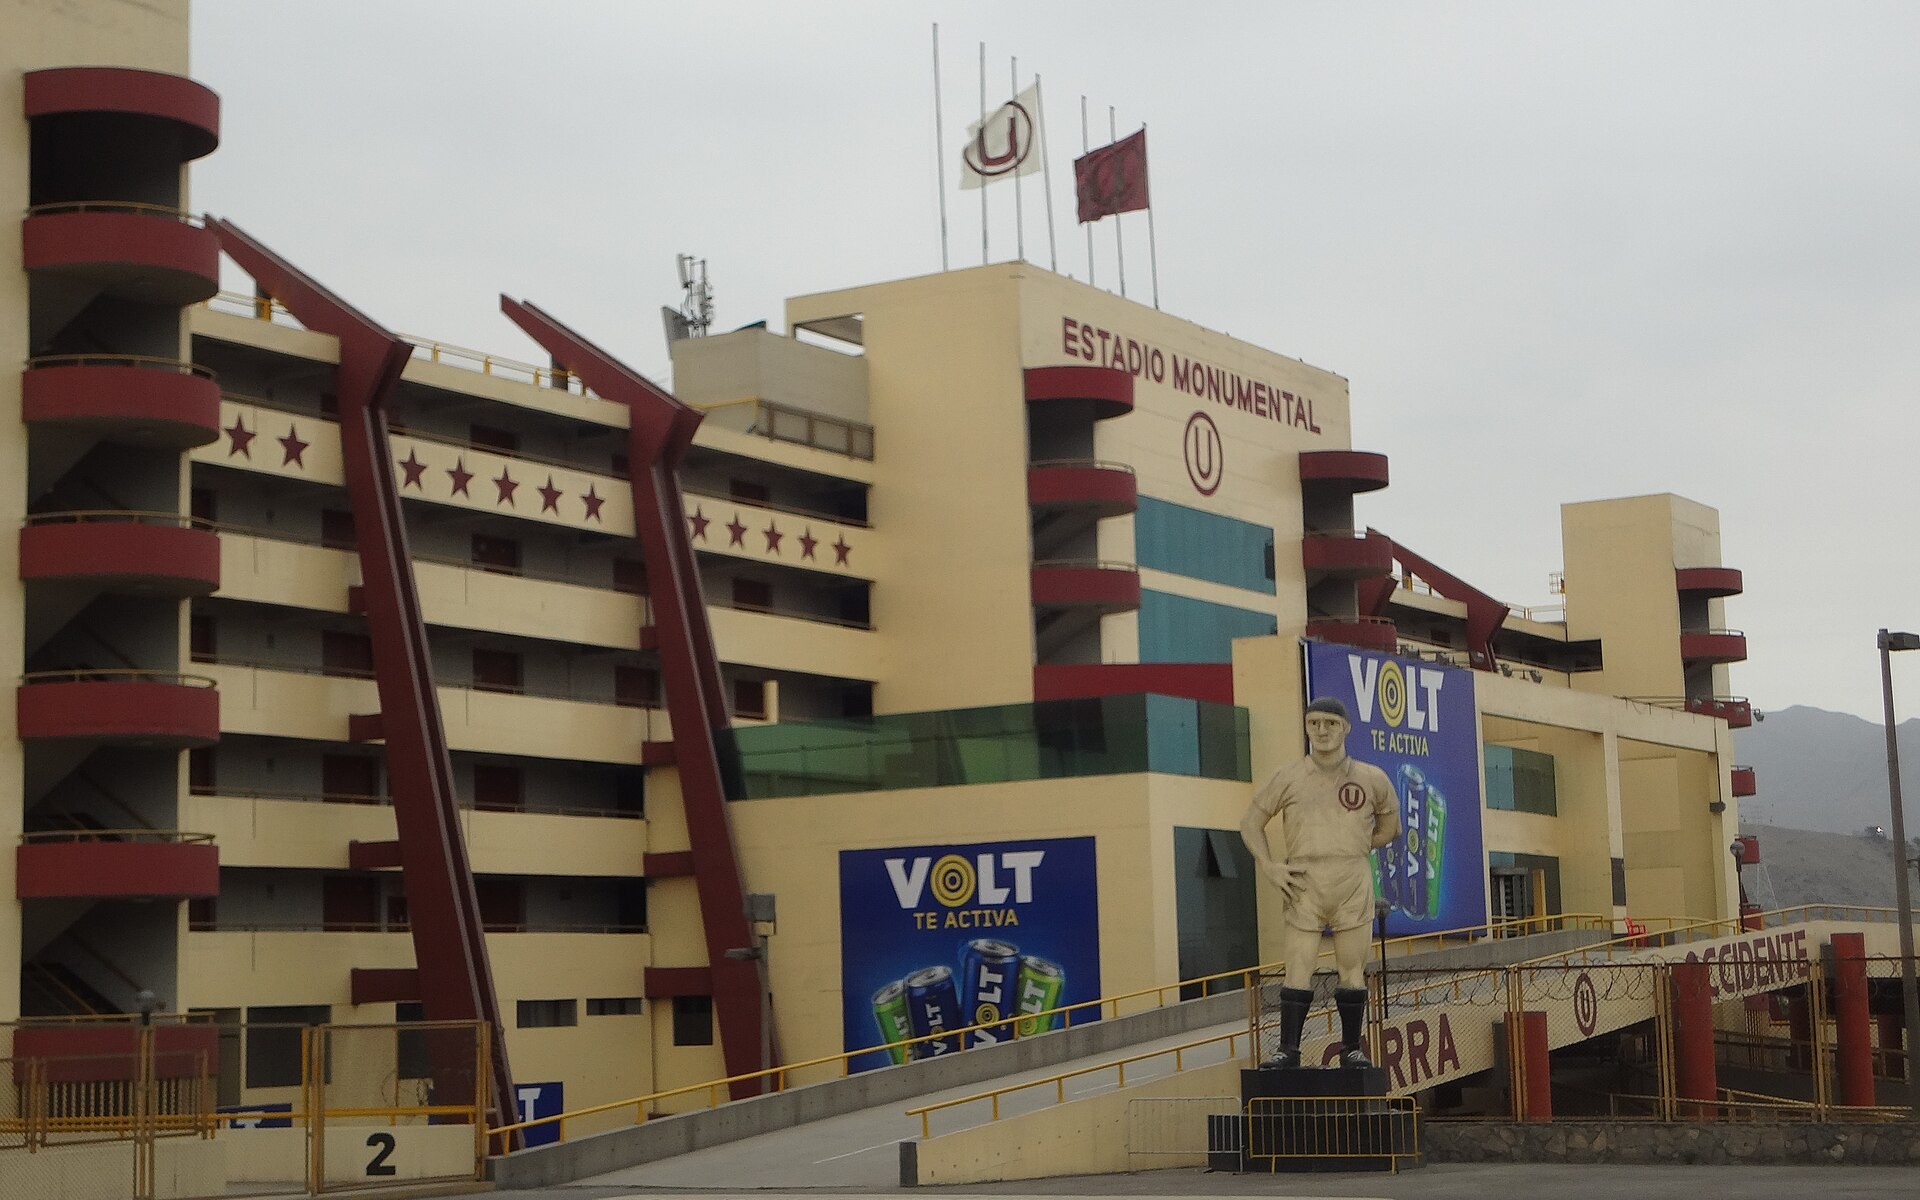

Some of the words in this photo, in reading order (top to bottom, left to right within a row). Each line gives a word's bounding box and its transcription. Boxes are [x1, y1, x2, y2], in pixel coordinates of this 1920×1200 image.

[1063, 316, 1165, 384] ESTADIO
[1172, 354, 1322, 435] MONUMENTAL
[1348, 653, 1445, 733] VOLT
[1371, 729, 1386, 752] TE
[1388, 732, 1430, 757] ACTIVA
[1407, 789, 1420, 878] VOLT
[884, 850, 1046, 909] VOLT
[913, 912, 938, 930] TE
[944, 908, 1019, 929] ACTIVA
[1020, 979, 1046, 1036] OLT
[1321, 1012, 1461, 1092] RRA
[366, 1132, 396, 1176] 2
